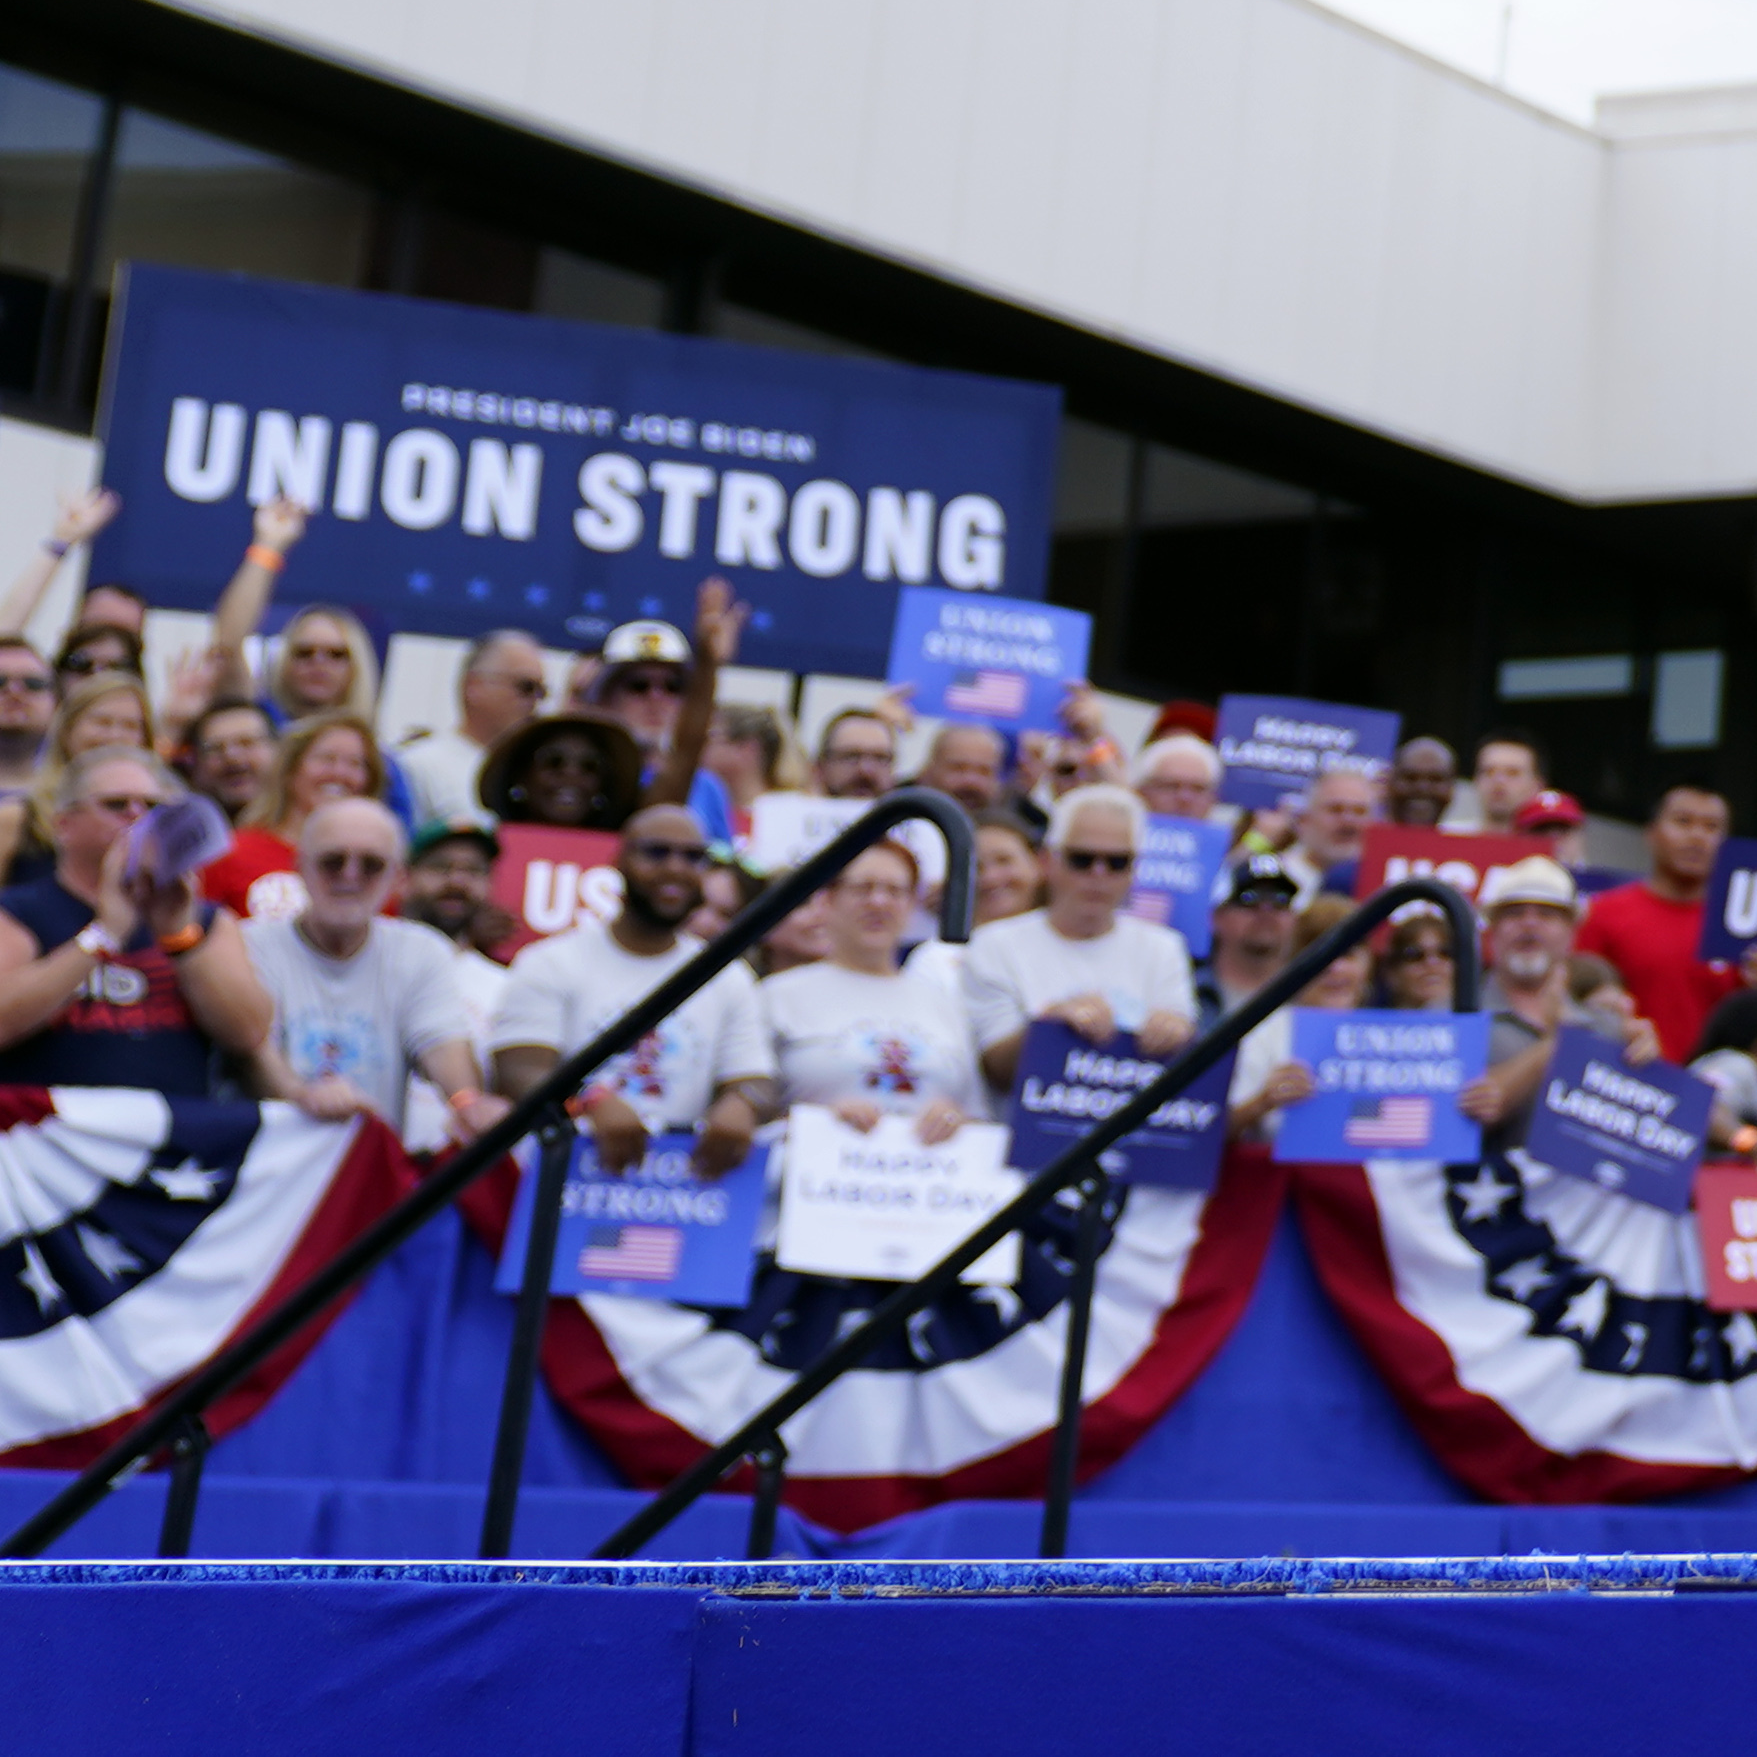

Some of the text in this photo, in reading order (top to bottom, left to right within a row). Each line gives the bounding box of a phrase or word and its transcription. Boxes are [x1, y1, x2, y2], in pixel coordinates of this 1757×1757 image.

[402, 382, 817, 463] PRESIDENT JOE BIDEN
[163, 396, 1008, 590] UNION STRONG
[939, 603, 1055, 643] UNION
[923, 630, 1062, 678] STRONG
[1335, 1023, 1457, 1059] UNION
[1063, 1049, 1167, 1091] HAPP
[1317, 1058, 1465, 1093] STRONG
[1545, 1077, 1639, 1140] LABOR
[561, 1180, 730, 1227] STRONG
